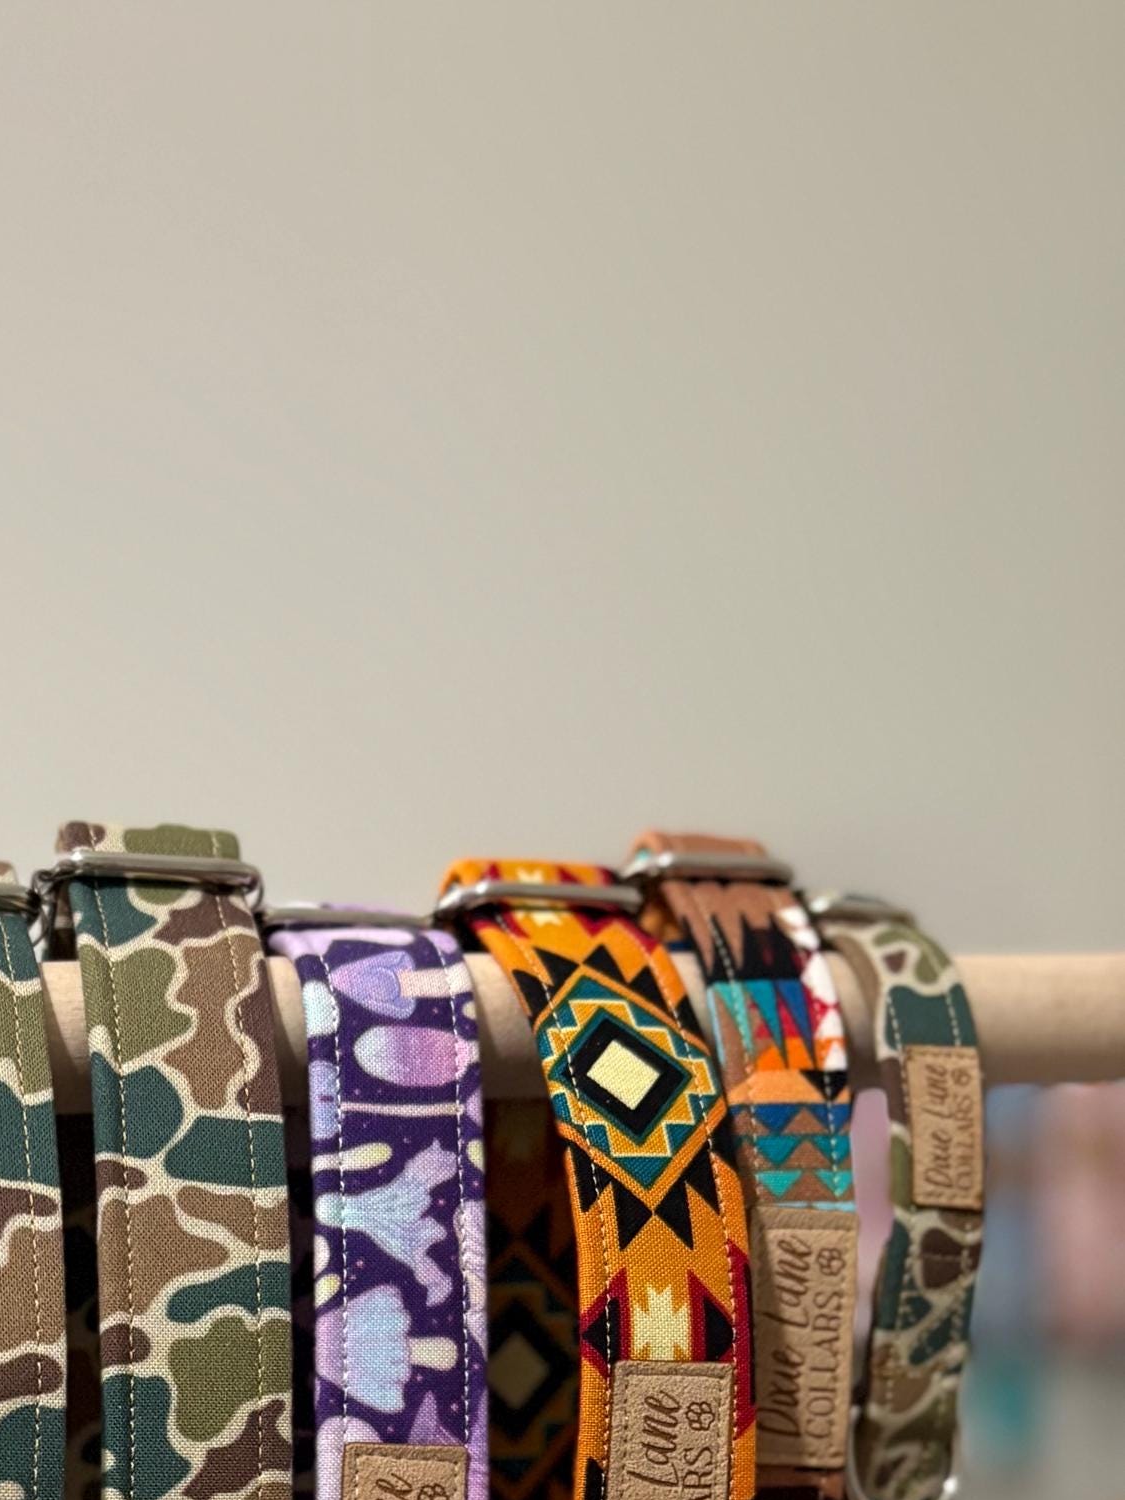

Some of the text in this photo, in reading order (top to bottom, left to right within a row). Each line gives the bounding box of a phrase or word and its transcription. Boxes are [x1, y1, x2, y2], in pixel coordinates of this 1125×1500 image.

[757, 1235, 813, 1438] Dixie Lane
[805, 1291, 843, 1439] COLLARS
[627, 1390, 680, 1488] Lane
